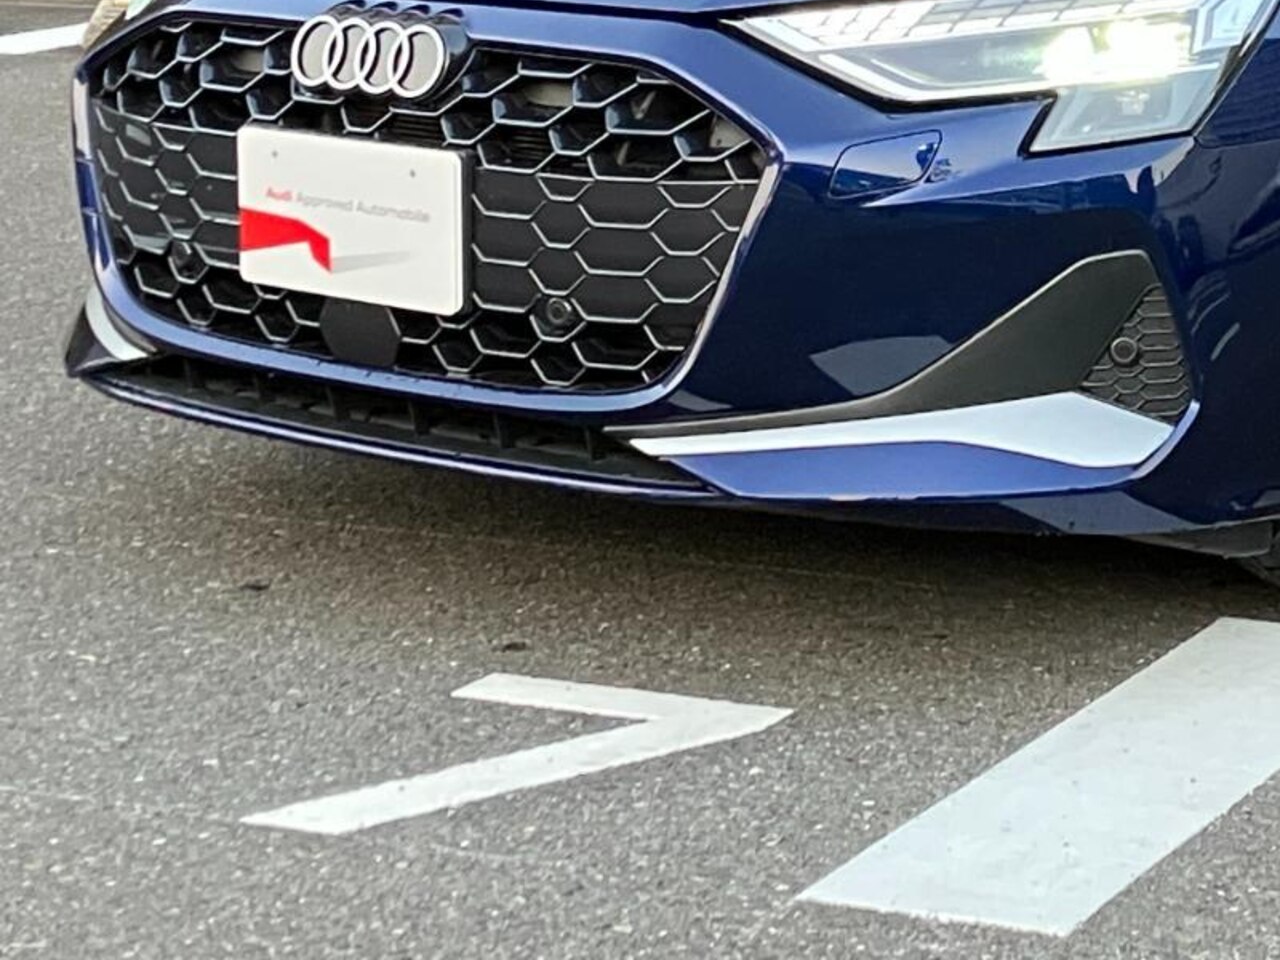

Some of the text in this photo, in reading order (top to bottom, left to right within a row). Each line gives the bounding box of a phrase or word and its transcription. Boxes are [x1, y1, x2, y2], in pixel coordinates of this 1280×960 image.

[265, 186, 430, 223] Audi Approved Automobile
